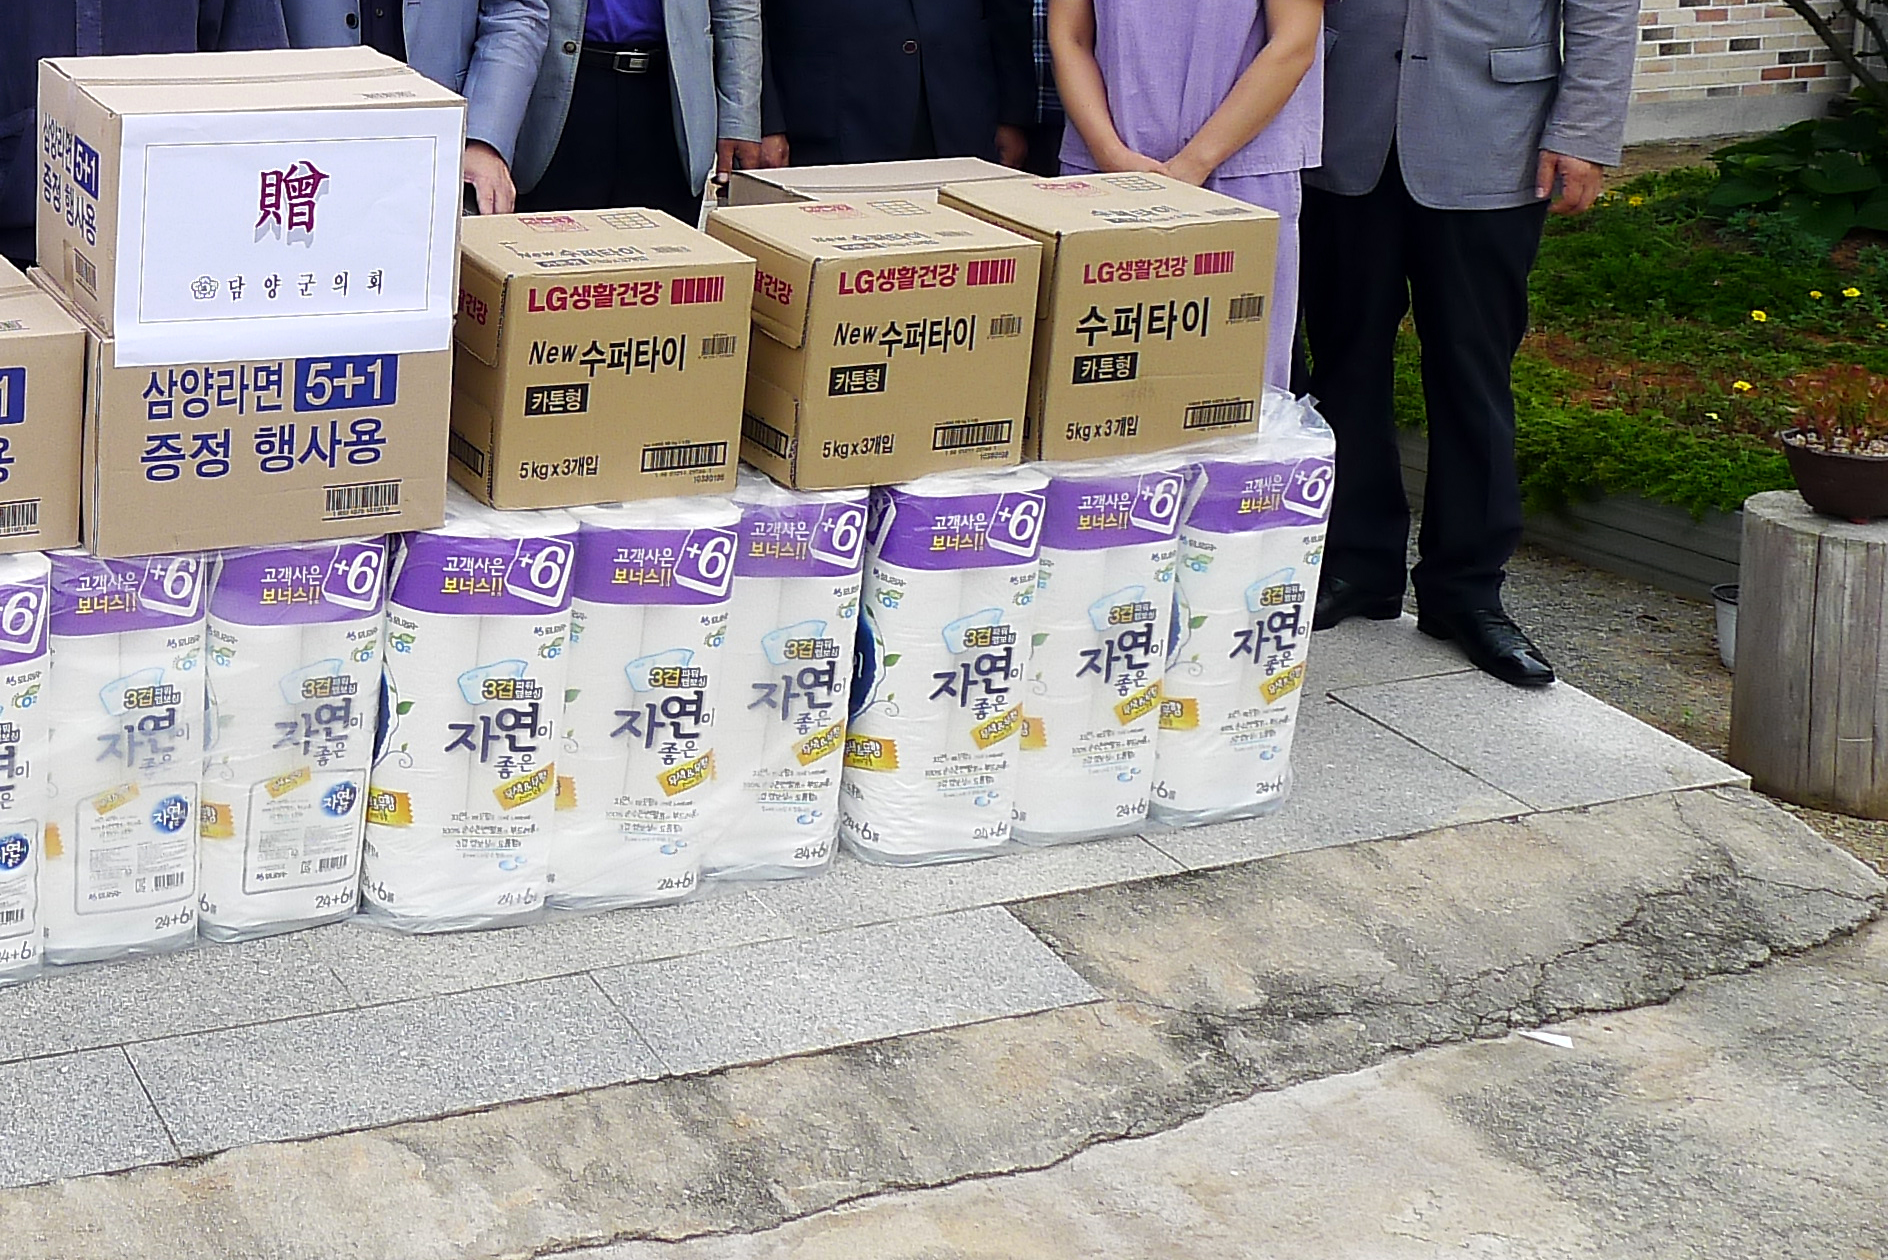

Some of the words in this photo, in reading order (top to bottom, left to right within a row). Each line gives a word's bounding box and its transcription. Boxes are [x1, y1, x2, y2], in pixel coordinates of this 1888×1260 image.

[839, 263, 959, 295] LG생활건강
[1084, 256, 1188, 284] LG생활건강
[528, 282, 662, 312] LG생활건강
[1076, 297, 1210, 346] 수퍼타이
[833, 323, 878, 347] New
[879, 315, 976, 357] 수퍼타이
[529, 341, 578, 365] New
[580, 334, 686, 377] 수퍼타이
[142, 361, 283, 421] 삼양라면
[304, 358, 384, 406] 5+1
[140, 428, 232, 482] 증정
[253, 418, 387, 473] 행사용
[1077, 493, 1131, 511] 고객사은
[750, 522, 810, 539] 고객사은
[931, 513, 988, 533] 고객사은
[748, 542, 807, 560] 보너스!!
[929, 533, 984, 551] 보너스!!
[442, 557, 505, 577] 고객사은
[613, 548, 675, 567] 고객사은
[260, 565, 323, 586] 고객사은
[611, 568, 672, 588] 보너스!!
[441, 577, 503, 597] 보너스!!
[964, 627, 993, 647] 3겹
[784, 639, 814, 658] 3겹
[649, 667, 680, 687] 3겹
[482, 679, 514, 700] 3겹
